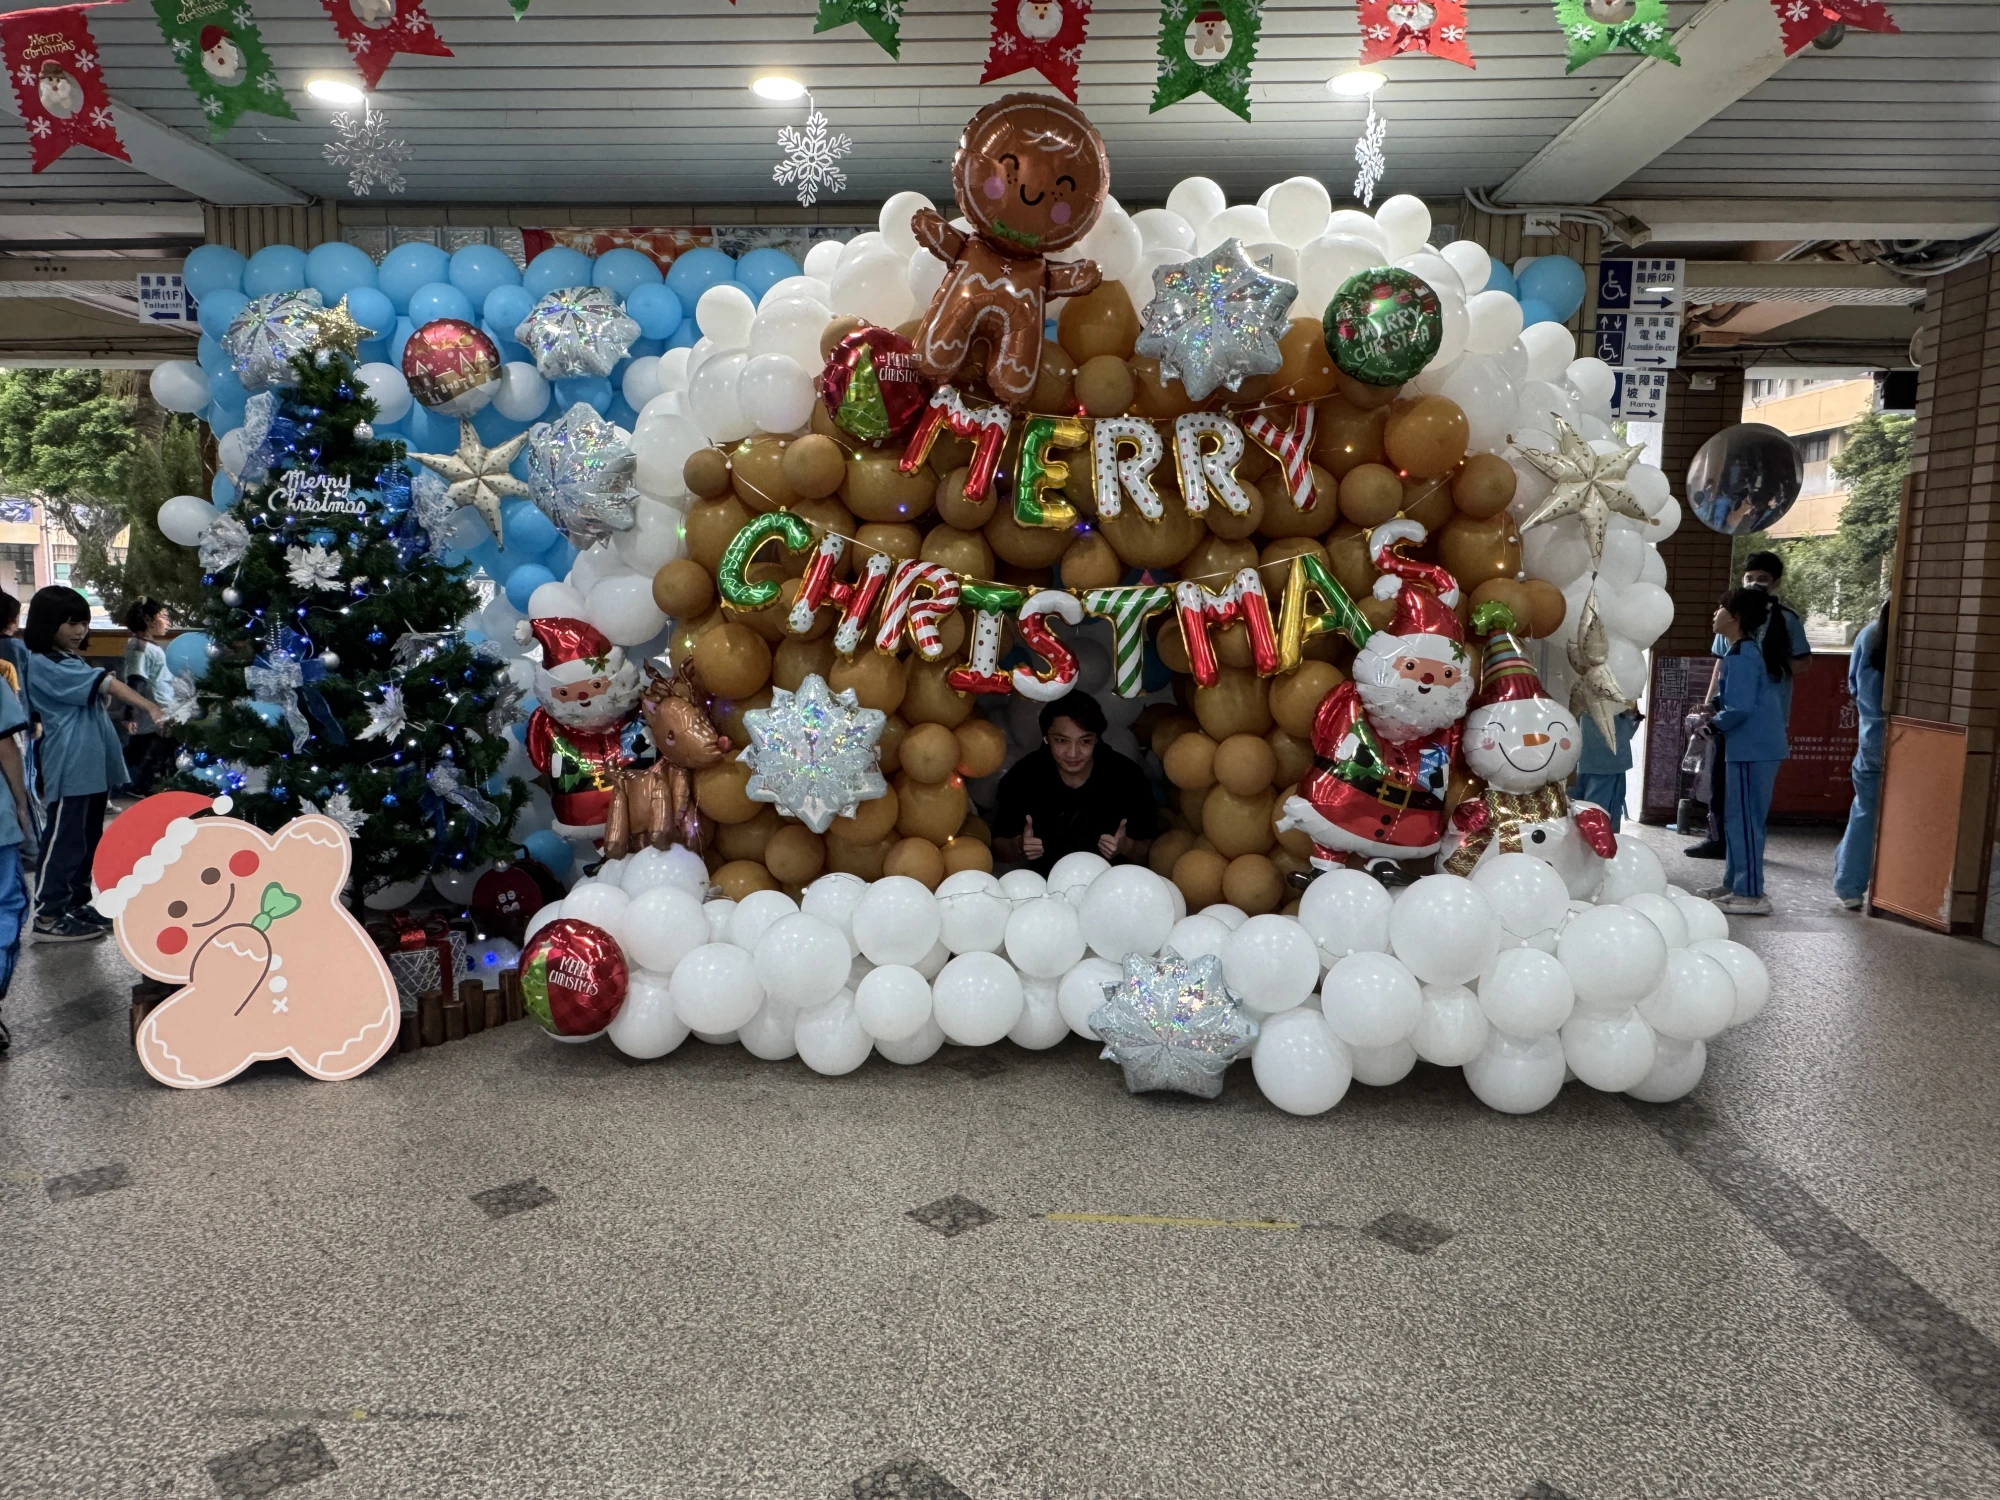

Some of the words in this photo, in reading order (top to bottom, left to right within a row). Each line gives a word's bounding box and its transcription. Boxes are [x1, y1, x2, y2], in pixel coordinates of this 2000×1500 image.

[28, 32, 63, 47] Merry
[879, 366, 920, 383] CHRISTM
[1624, 374, 1665, 386] 無障礙
[1626, 388, 1661, 400] 坡道
[1629, 400, 1656, 408] Ramp
[900, 384, 1318, 531] MERRY
[280, 469, 351, 499] Merry
[267, 487, 367, 514] Christmas
[719, 510, 1460, 702] CHRISTMAS
[548, 969, 599, 996] CHRISTMAS
